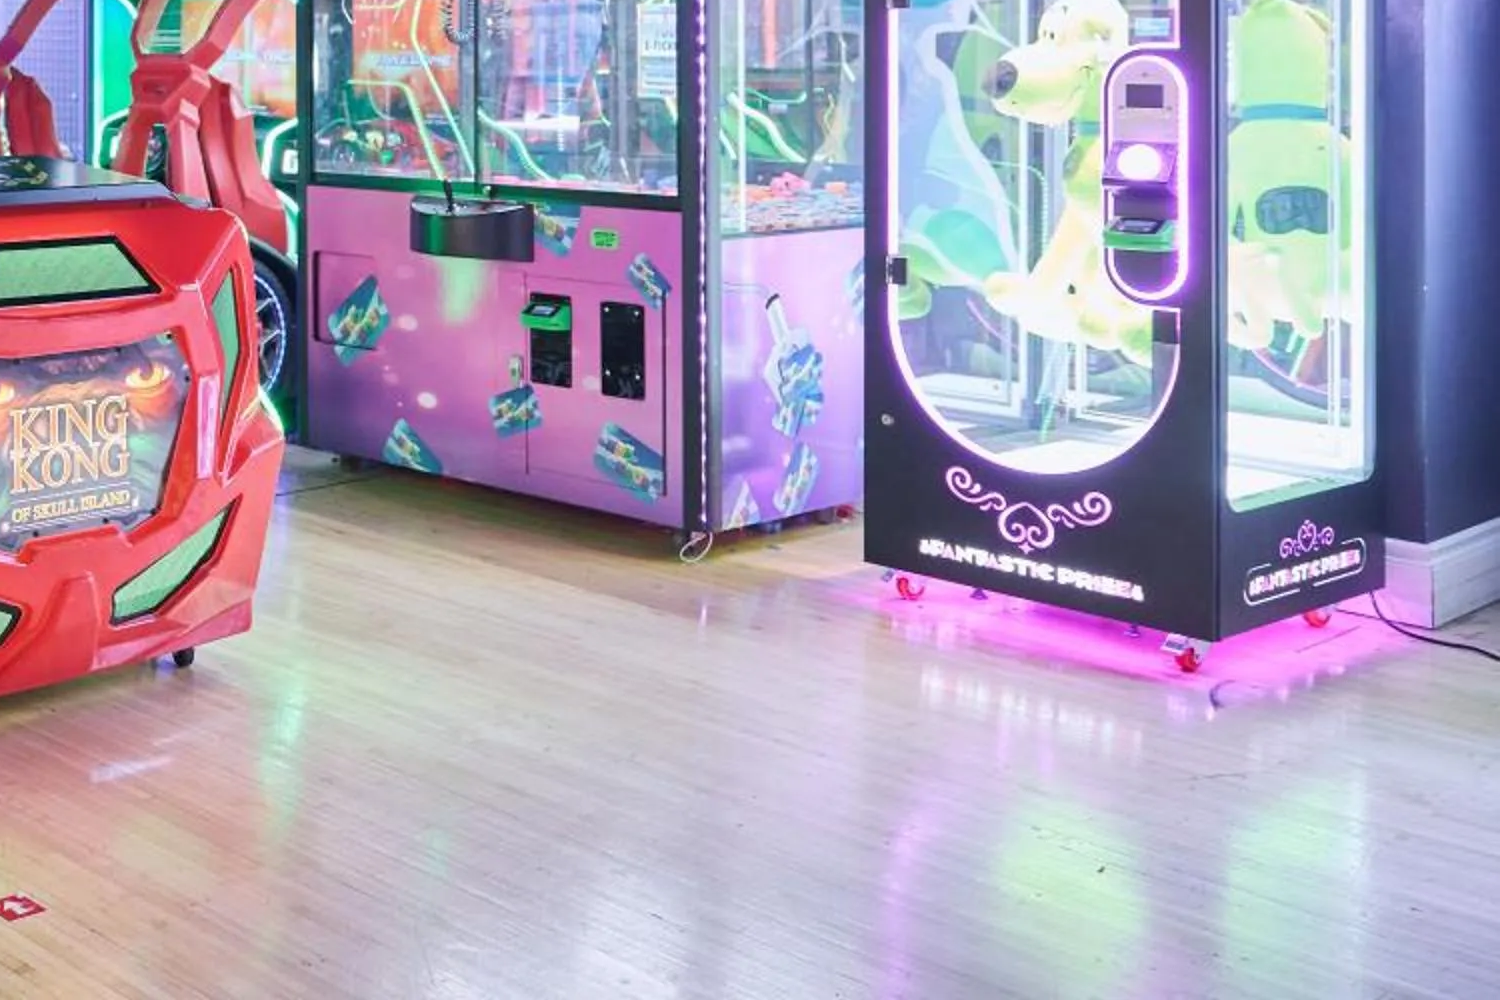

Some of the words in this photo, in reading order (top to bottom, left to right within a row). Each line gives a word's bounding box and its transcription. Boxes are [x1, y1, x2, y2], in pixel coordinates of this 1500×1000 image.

[8, 395, 129, 450] KING
[9, 437, 130, 494] KONG
[12, 506, 31, 523] OF
[33, 497, 79, 521] SKULL
[81, 488, 131, 512] ISLAND
